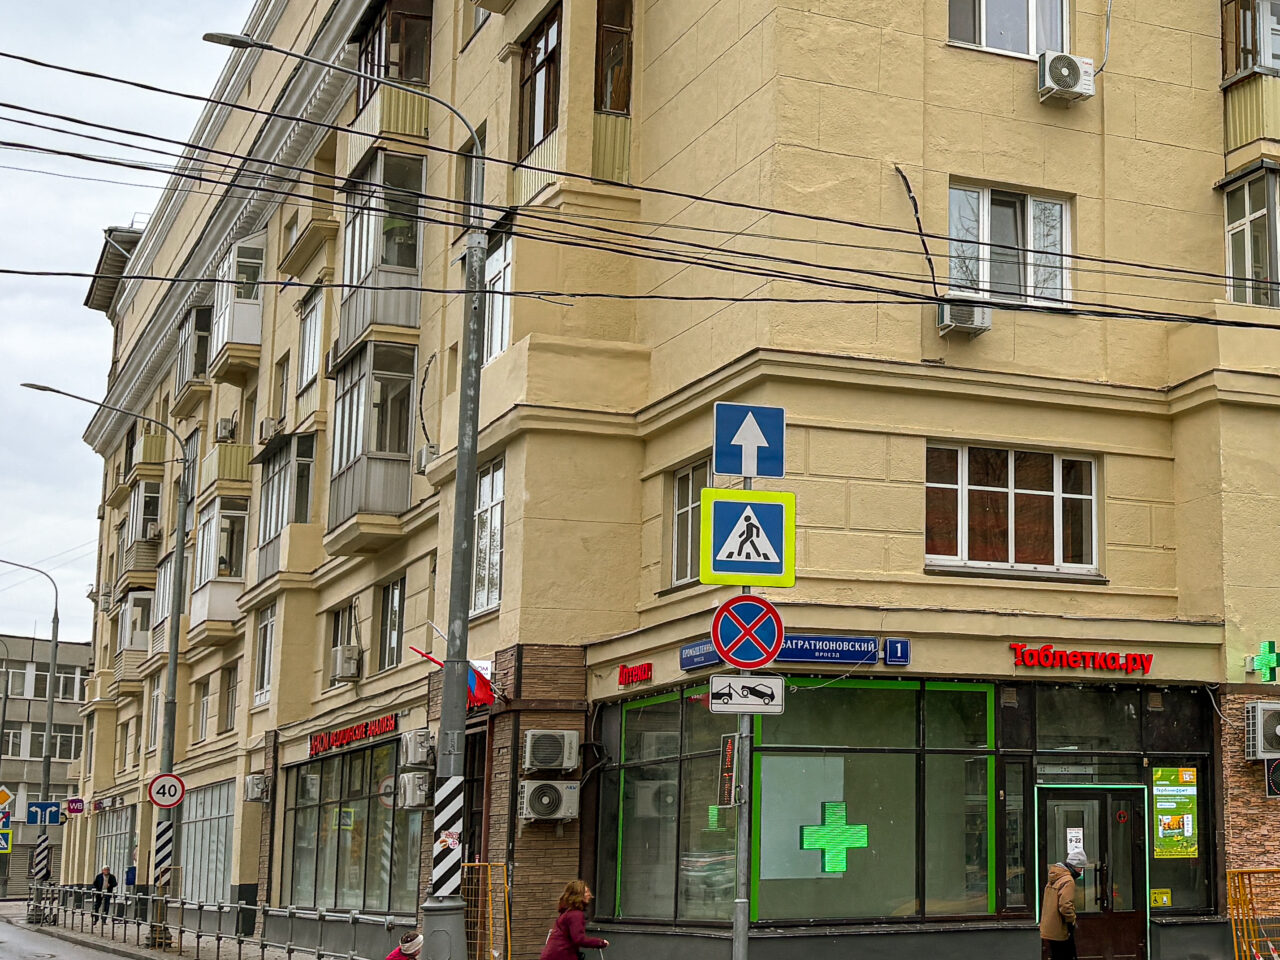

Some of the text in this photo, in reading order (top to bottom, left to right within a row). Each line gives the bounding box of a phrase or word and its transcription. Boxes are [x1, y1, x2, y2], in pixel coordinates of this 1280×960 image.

[682, 642, 717, 659] ПРОМЫШЛЕННЫ
[781, 640, 875, 652] БАГРАТИОНОВСКИЙ
[895, 643, 902, 657] 1
[1009, 642, 1154, 675] Таблетка.ру
[367, 713, 396, 737] АНАЛИЗЫ
[156, 784, 177, 798] 40
[70, 802, 83, 810] WB
